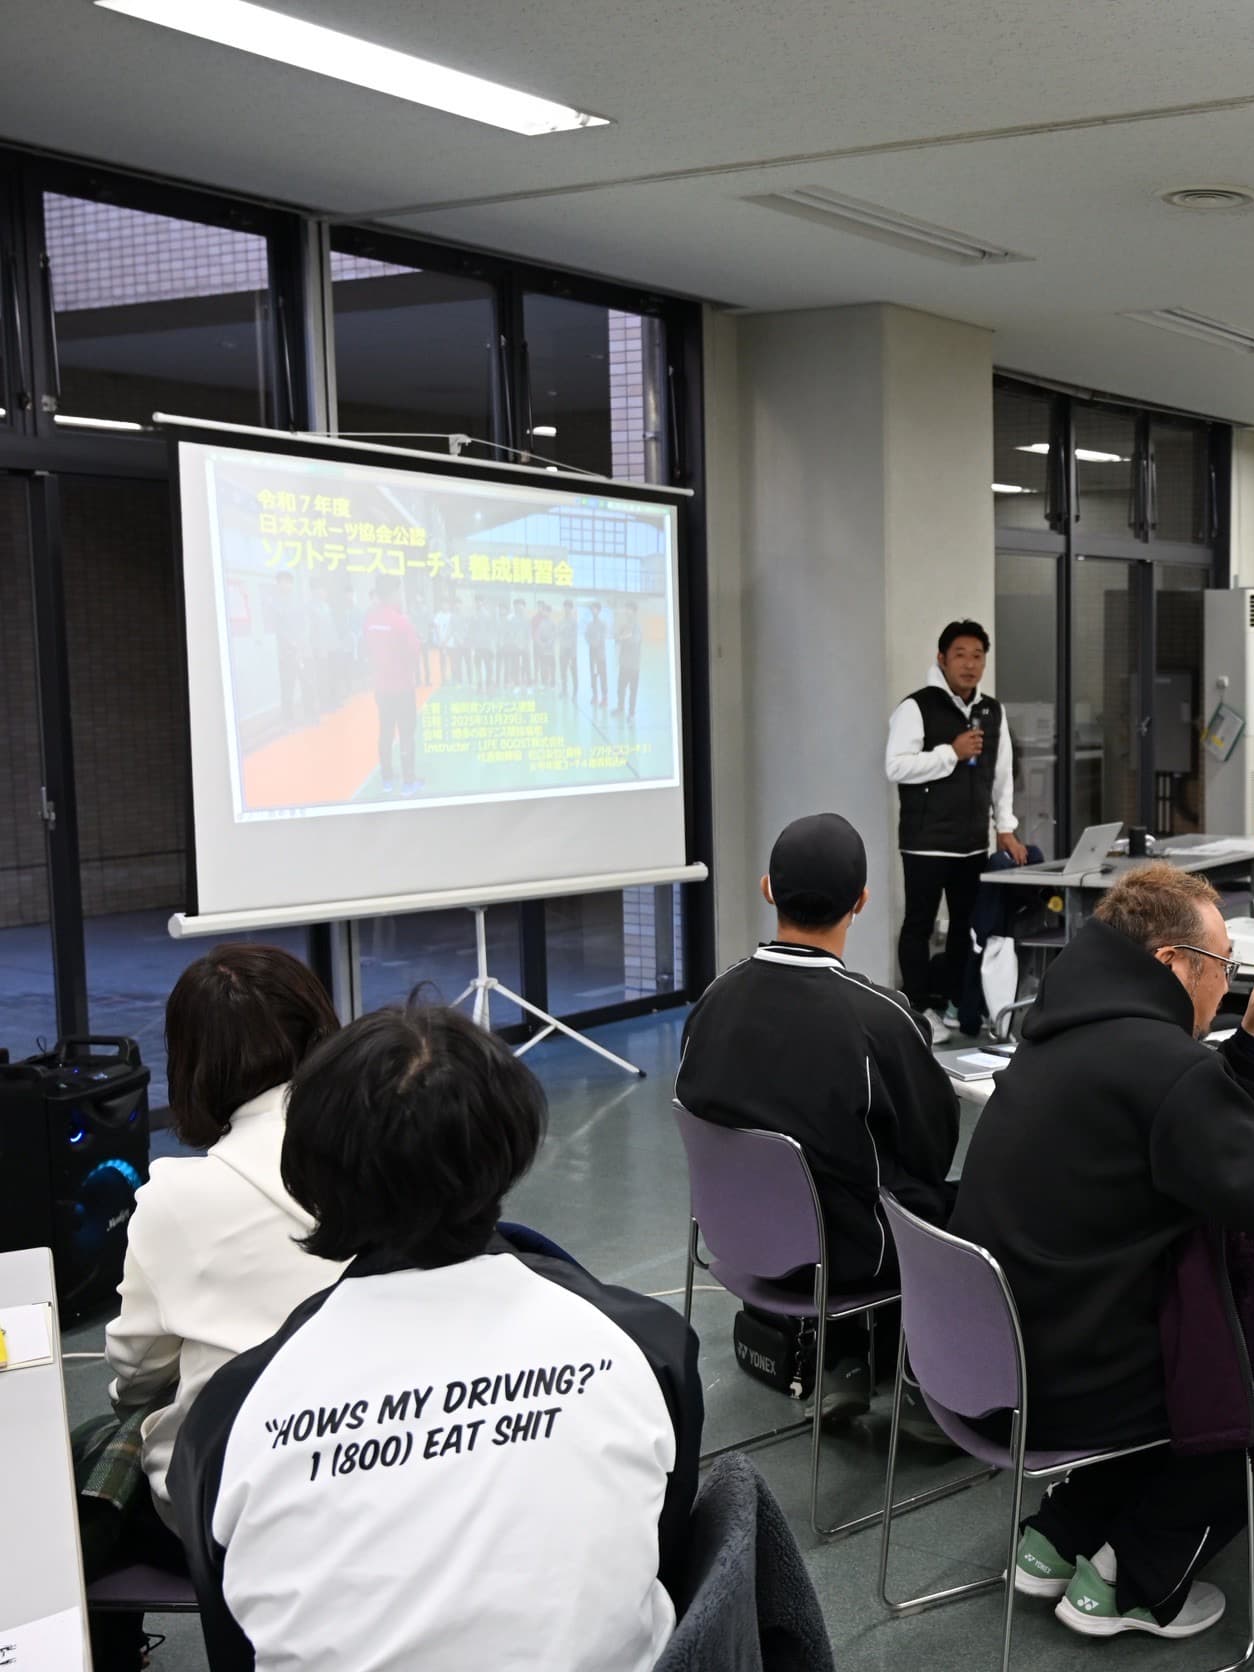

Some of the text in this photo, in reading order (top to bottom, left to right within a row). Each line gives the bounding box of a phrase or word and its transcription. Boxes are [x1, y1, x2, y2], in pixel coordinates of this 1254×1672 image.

[749, 1350, 777, 1375] YONEX
[378, 1386, 433, 1425] MY
[332, 1432, 413, 1477] (800)
[423, 1419, 486, 1460] EAT
[491, 1407, 562, 1446] SHIT
